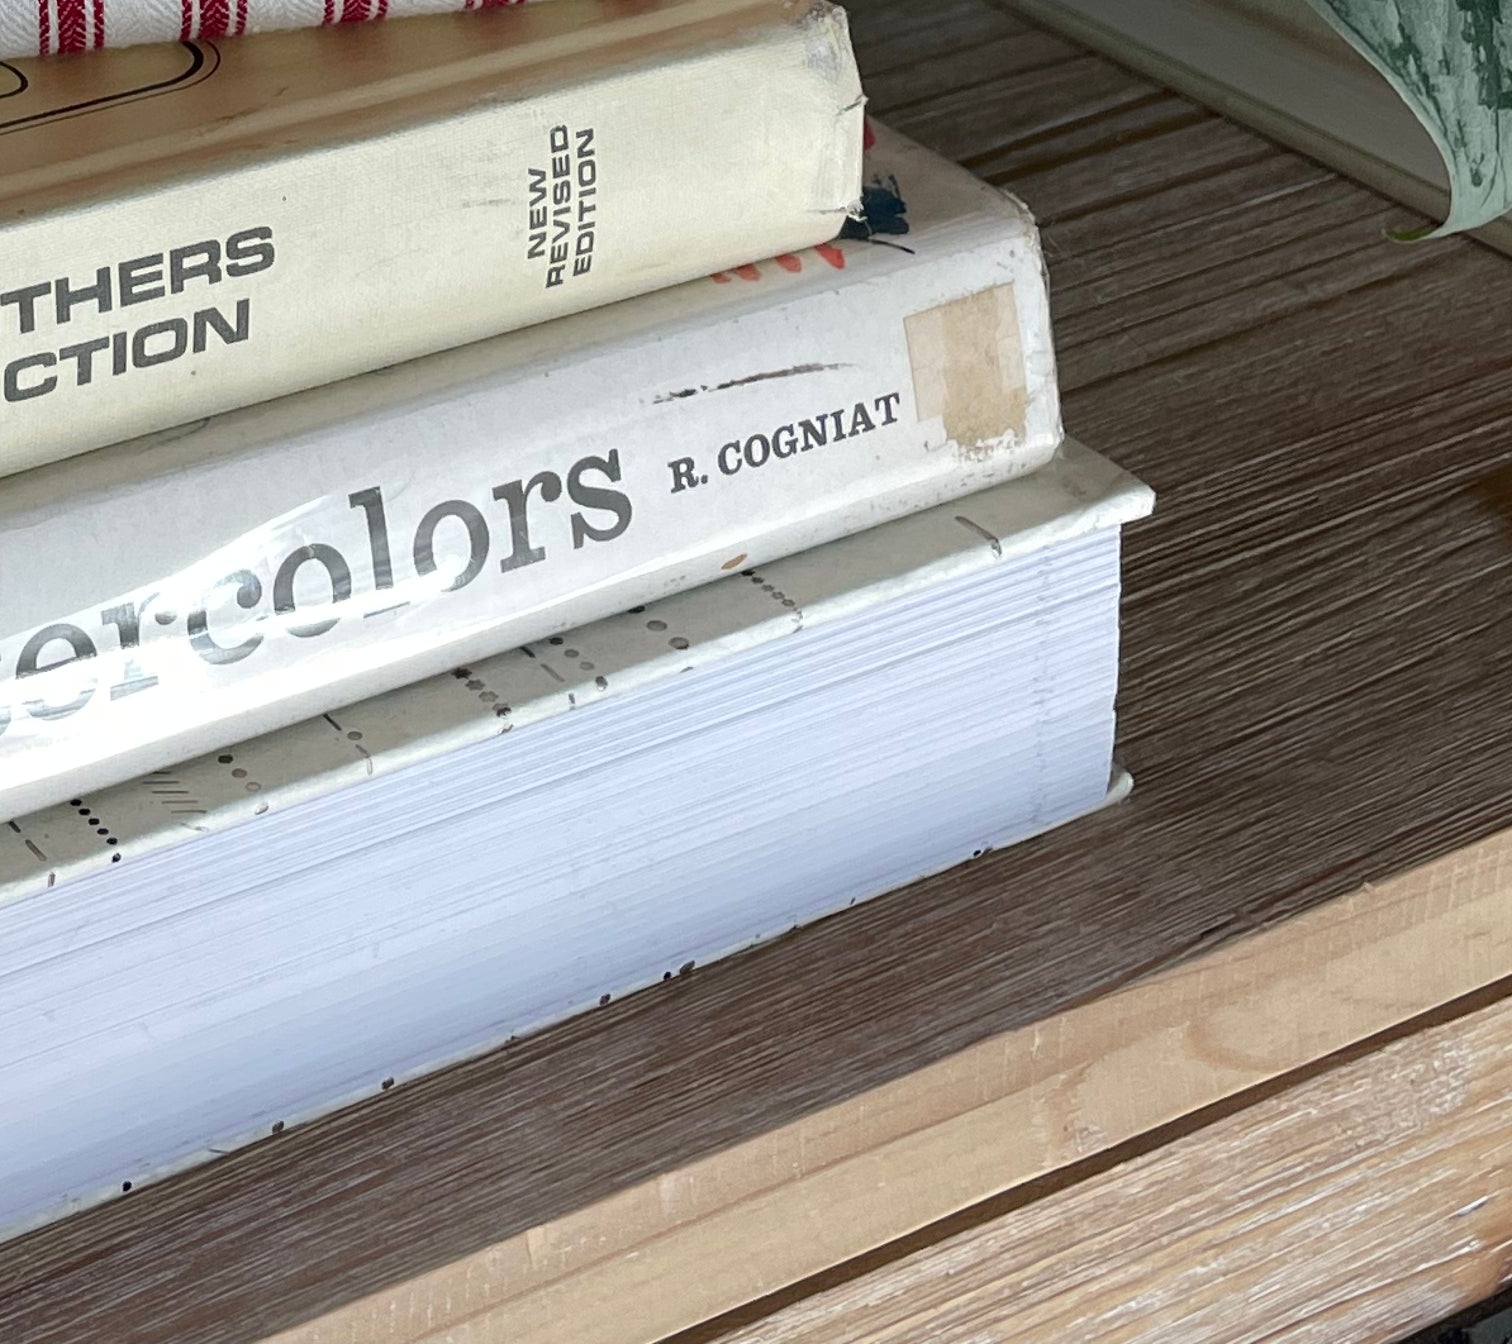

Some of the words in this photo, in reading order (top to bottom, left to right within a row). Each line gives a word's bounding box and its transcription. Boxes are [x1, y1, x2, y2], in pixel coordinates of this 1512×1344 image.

[527, 167, 548, 260] NEW
[545, 124, 572, 289] REVISED
[572, 127, 597, 277] EDITION
[667, 456, 709, 494] R.
[717, 392, 901, 476] COGNIAT
